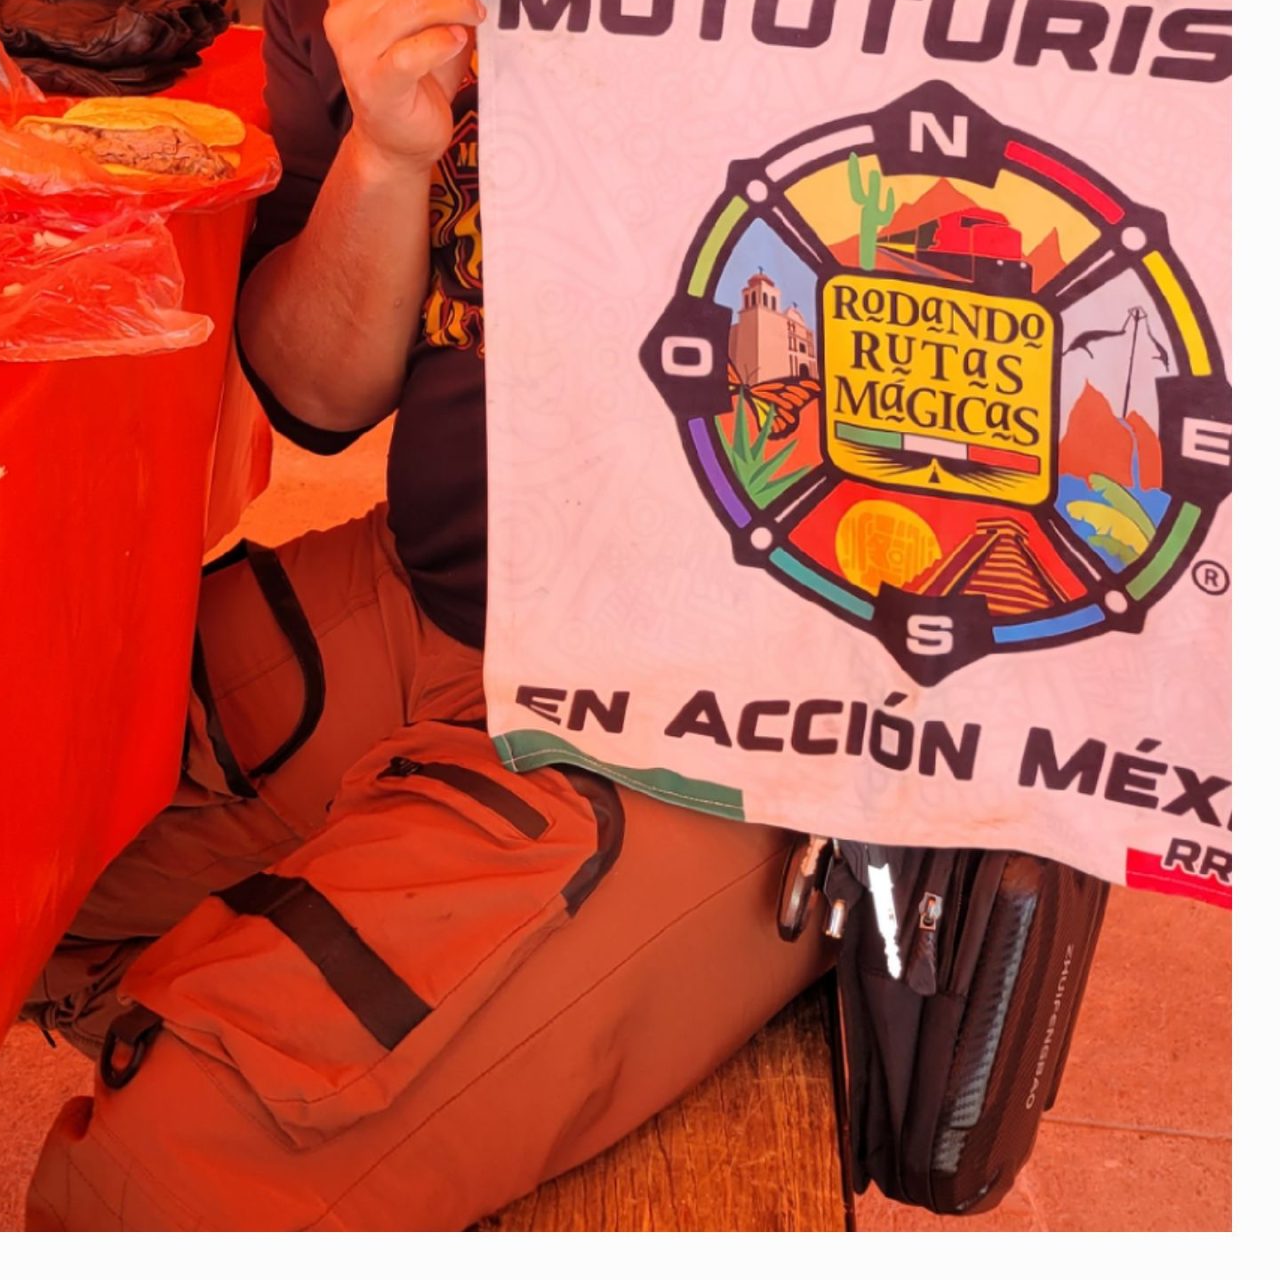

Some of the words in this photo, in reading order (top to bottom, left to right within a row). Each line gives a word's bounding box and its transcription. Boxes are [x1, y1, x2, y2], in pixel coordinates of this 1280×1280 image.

[908, 110, 969, 158] N
[661, 336, 714, 377] O
[1181, 416, 1232, 467] E
[906, 613, 954, 656] S
[514, 684, 630, 734] EN
[664, 691, 982, 782] ACCIÓN
[1017, 726, 1232, 833] MÉX
